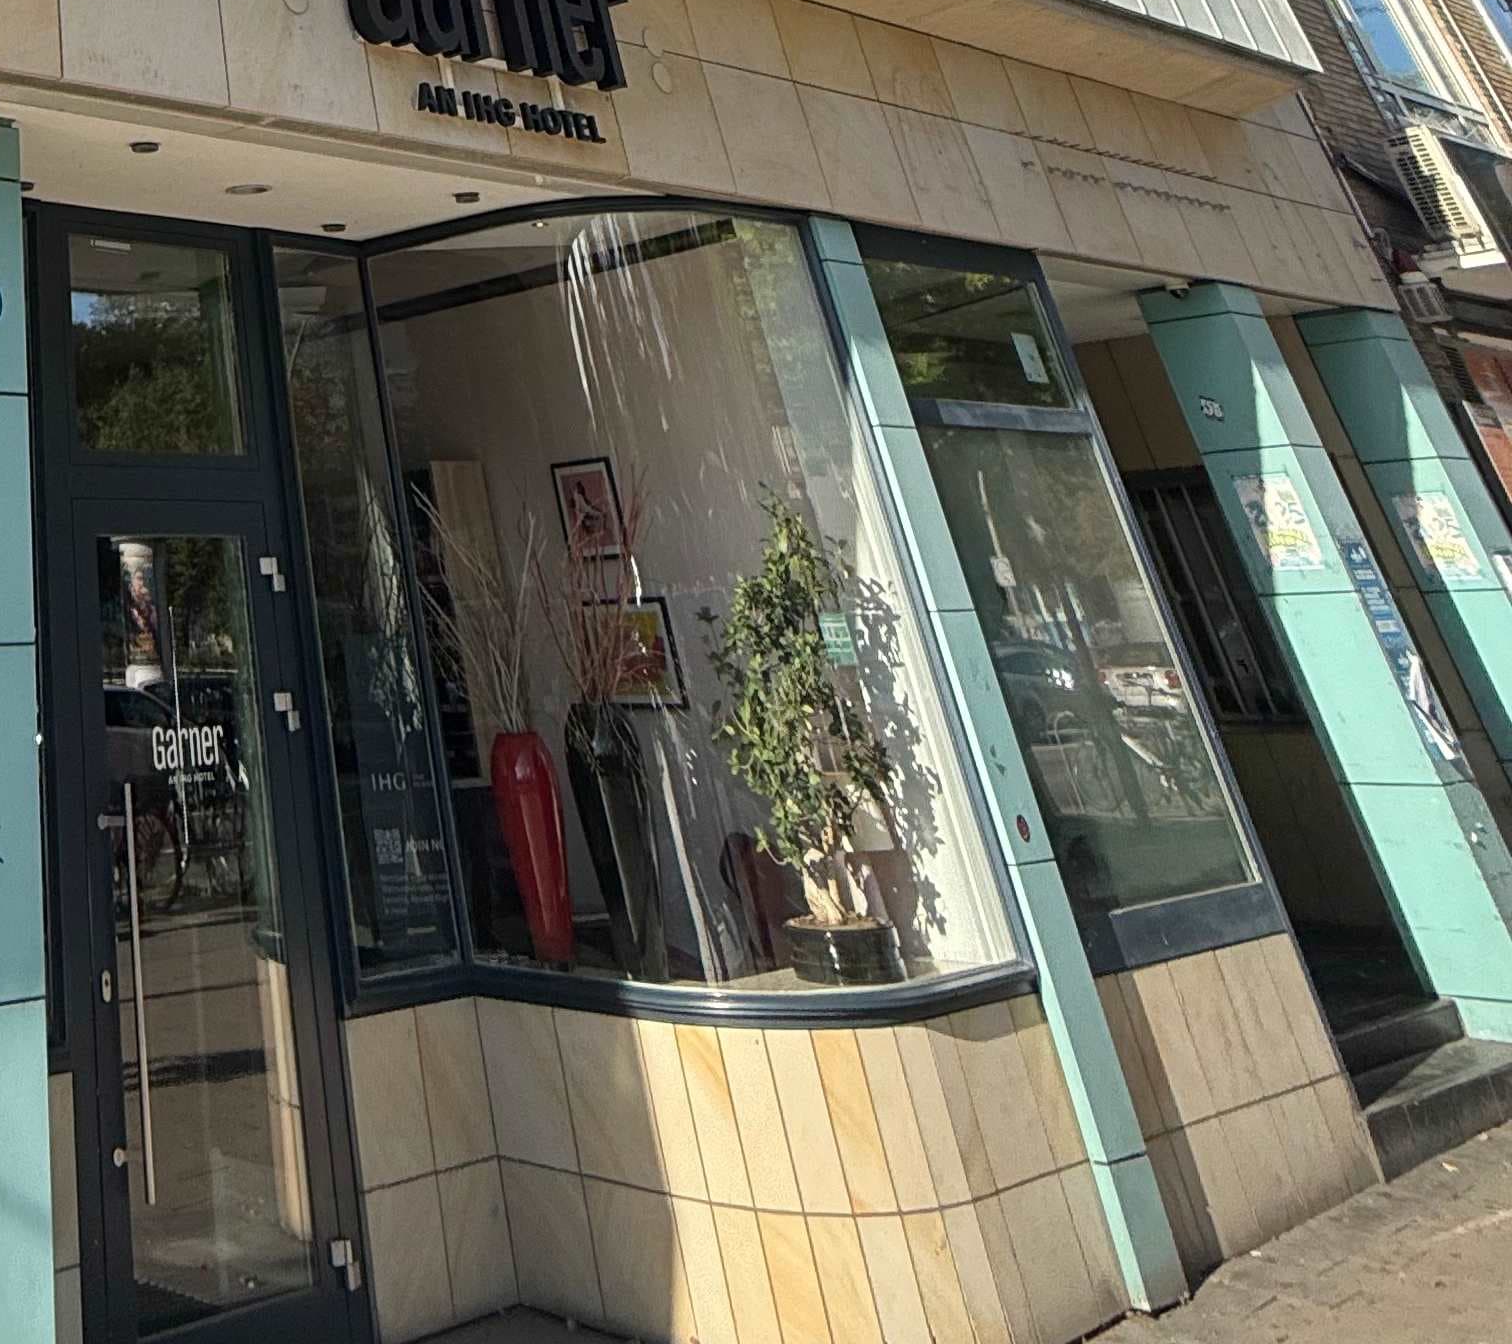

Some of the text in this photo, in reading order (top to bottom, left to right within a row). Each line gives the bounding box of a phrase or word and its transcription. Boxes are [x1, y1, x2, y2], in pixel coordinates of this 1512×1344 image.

[418, 81, 607, 144] AN IHG HOTEL
[152, 724, 224, 771] Garner
[193, 771, 216, 784] HOTEL
[370, 772, 407, 792] IHG
